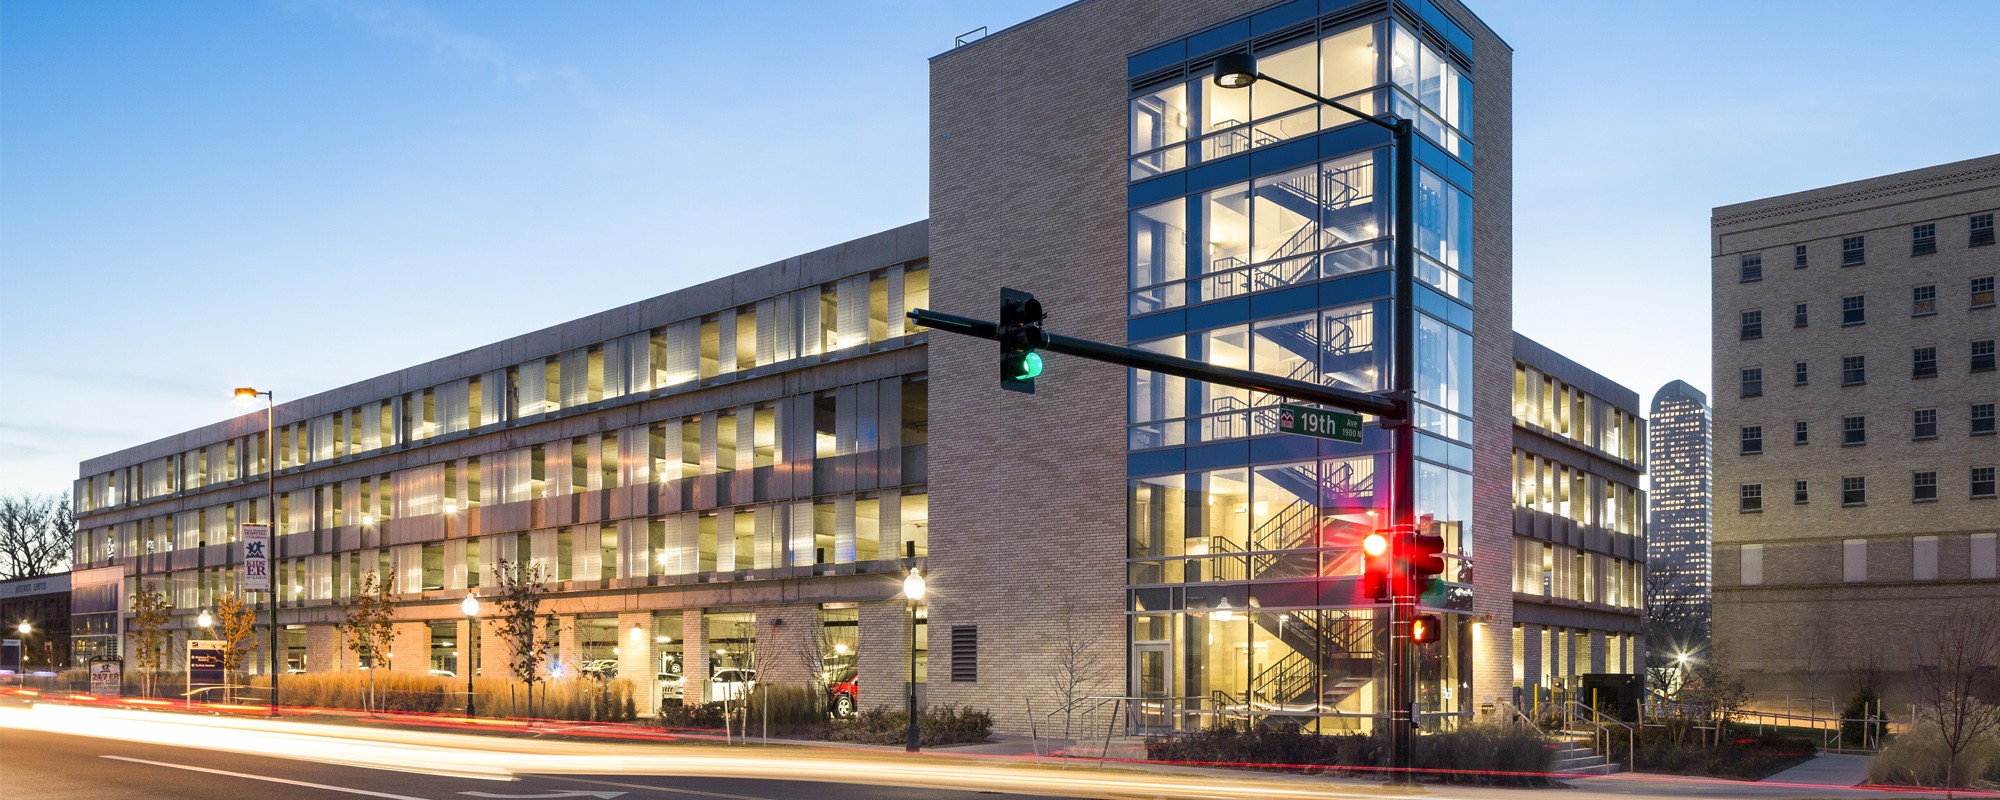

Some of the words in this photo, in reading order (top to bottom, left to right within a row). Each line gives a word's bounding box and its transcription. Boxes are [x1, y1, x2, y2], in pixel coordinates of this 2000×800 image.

[1301, 412, 1336, 434] 19th
[1346, 419, 1358, 428] Ave
[1342, 428, 1356, 438] 1900
[246, 566, 266, 575] ER
[34, 582, 46, 590] LOFTS
